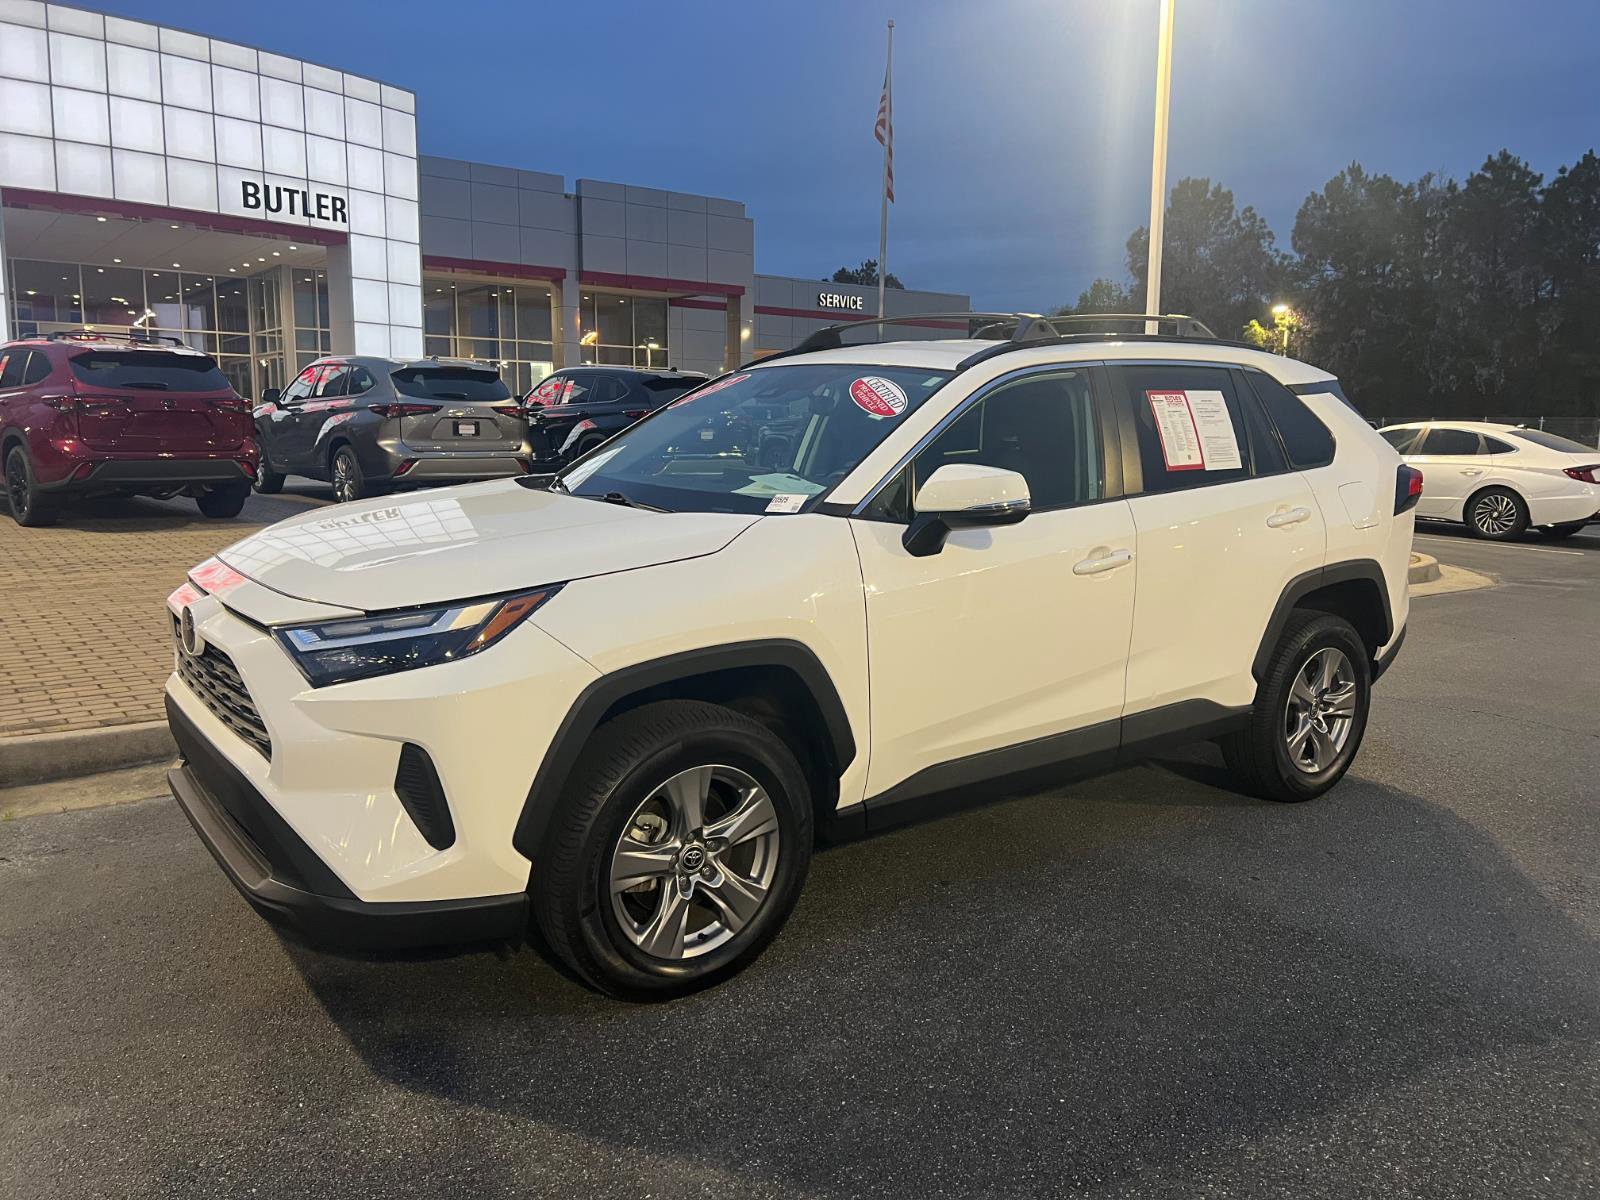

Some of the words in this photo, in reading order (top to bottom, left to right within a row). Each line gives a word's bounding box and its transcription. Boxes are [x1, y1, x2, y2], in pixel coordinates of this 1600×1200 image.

[241, 180, 348, 224] BUTLER
[819, 292, 863, 310] SERVICE
[855, 389, 878, 411] VEHICLE
[857, 383, 889, 411] PRE-OWNED
[866, 378, 905, 409] CERTIFIED
